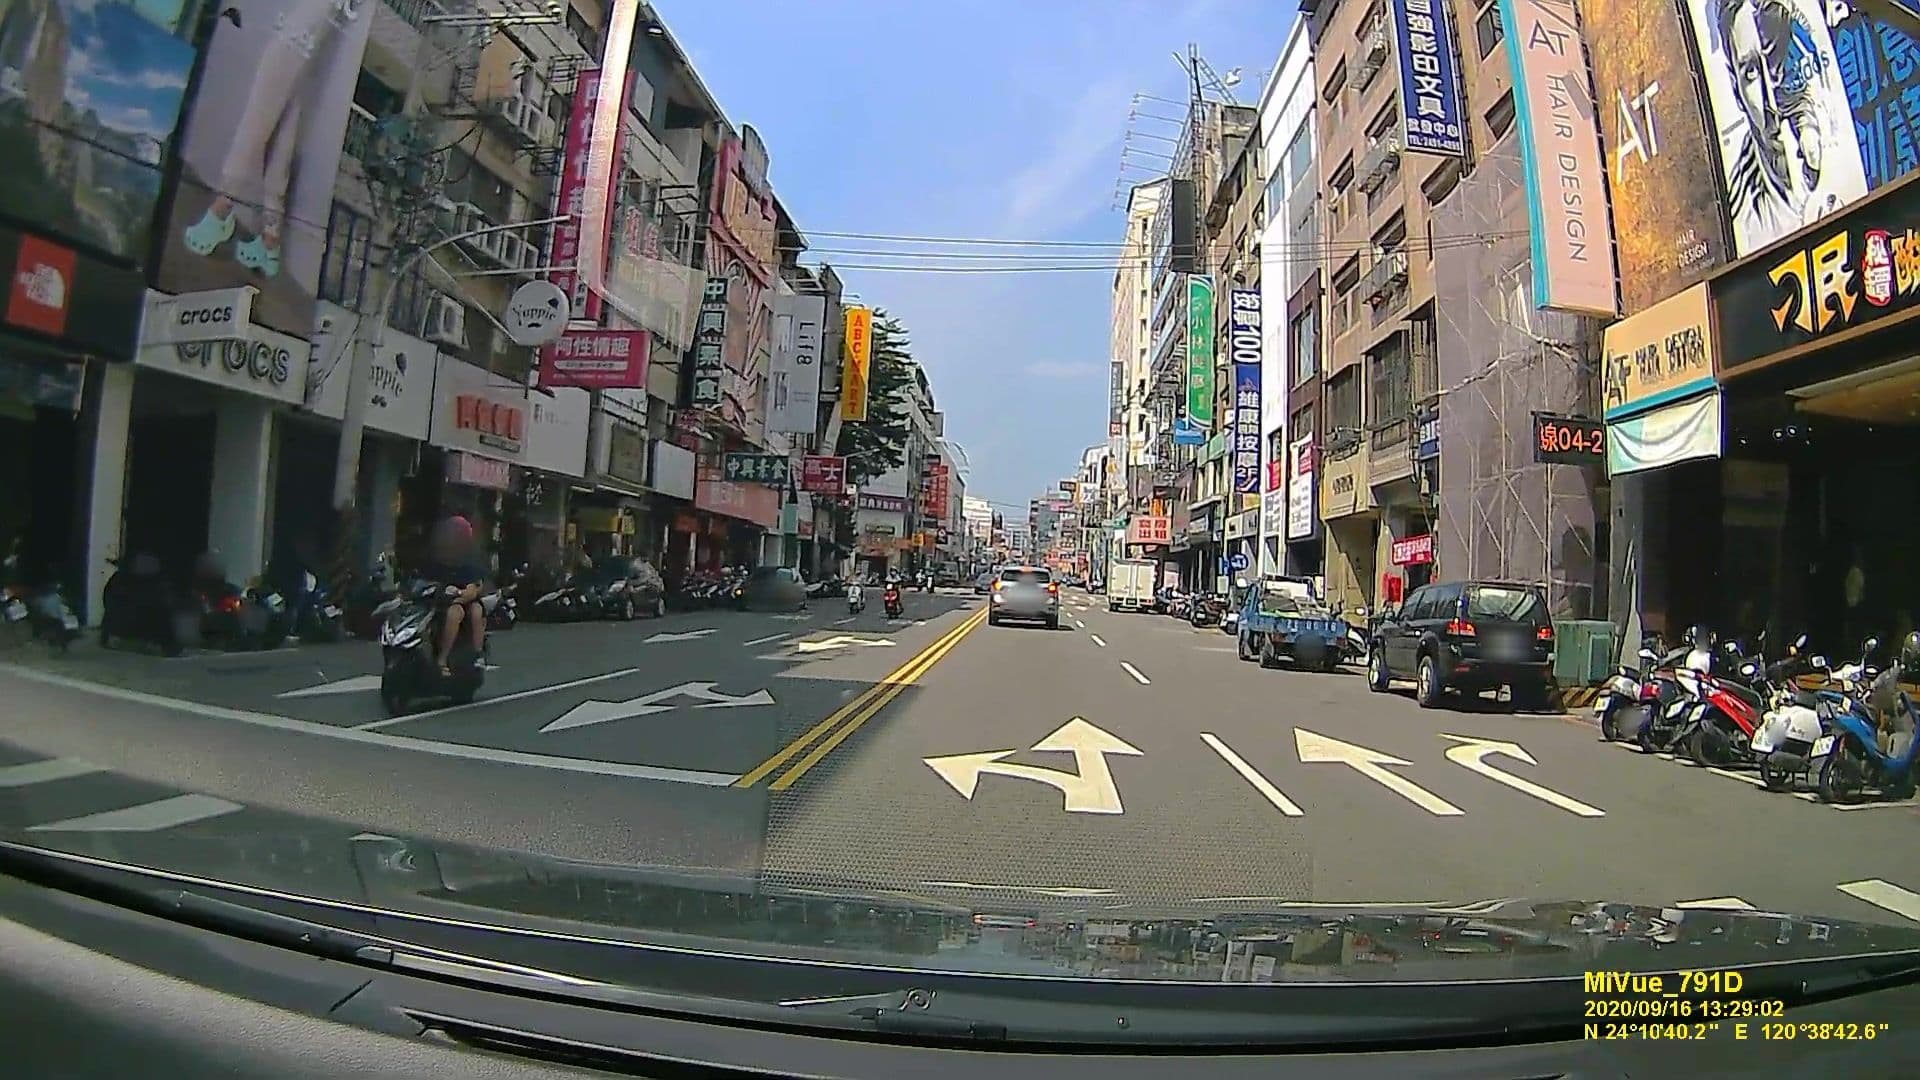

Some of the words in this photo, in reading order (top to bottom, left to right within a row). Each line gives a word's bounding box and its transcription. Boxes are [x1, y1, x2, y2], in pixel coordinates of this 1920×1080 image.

[1529, 19, 1570, 56] AT
[1546, 74, 1573, 139] HAIR
[1616, 80, 1660, 185] AT
[1558, 153, 1587, 261] DESIGN
[1678, 240, 1709, 268] DESIGN
[181, 306, 232, 325] crocs
[512, 304, 556, 327] Yuppie
[727, 457, 787, 479] 中興素食
